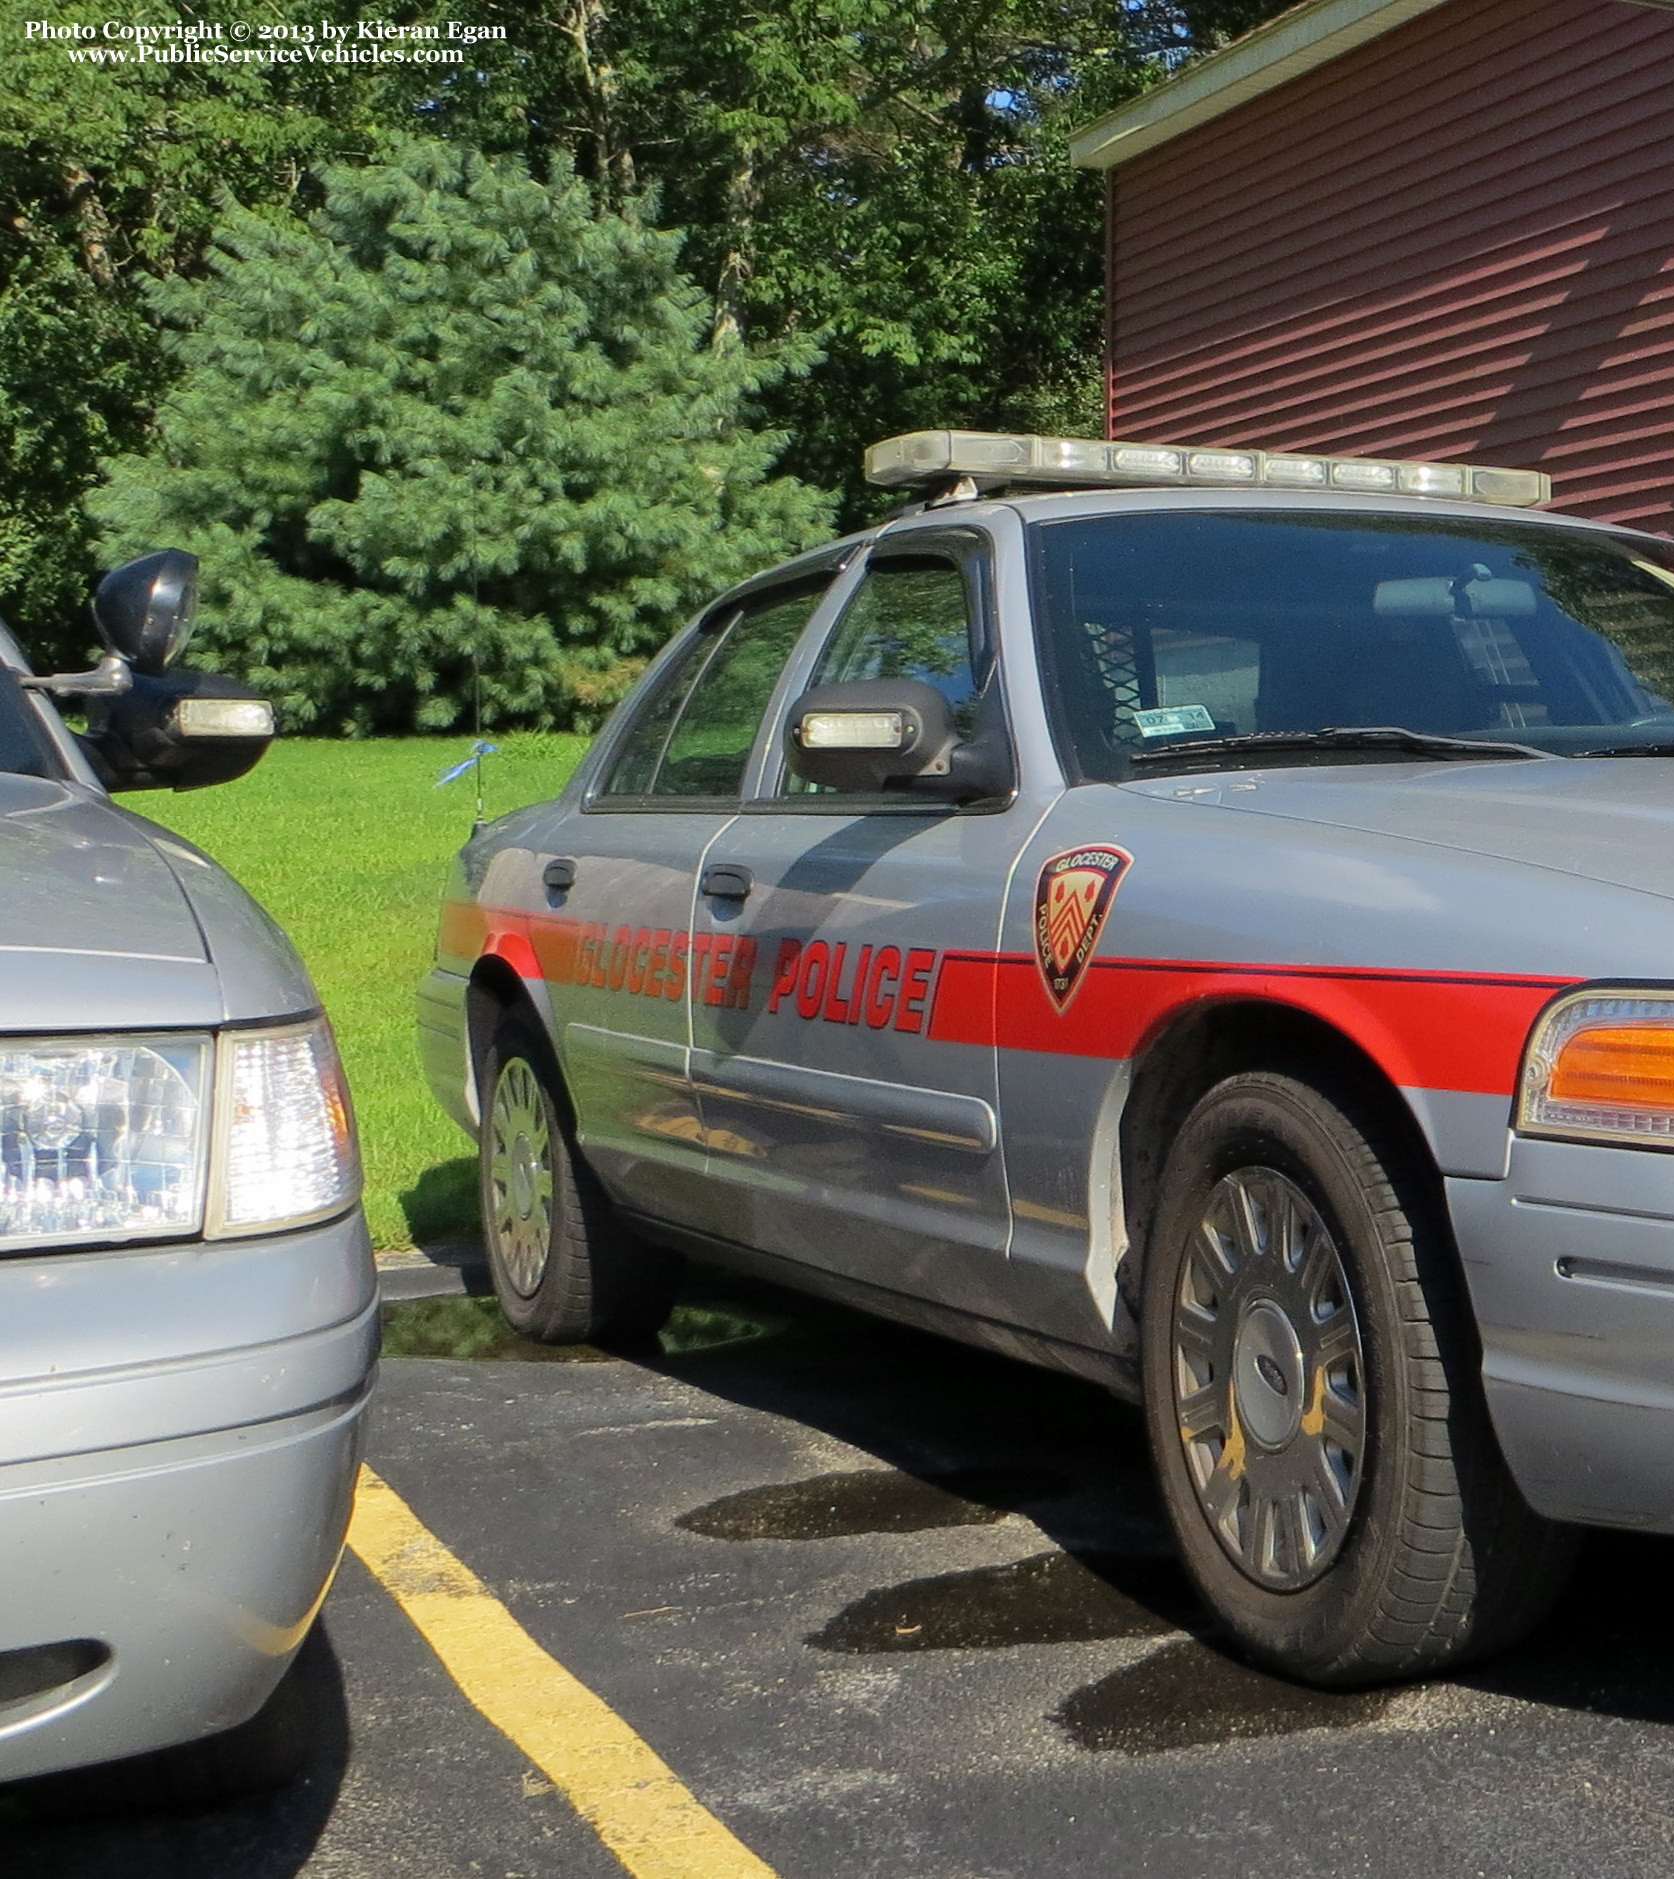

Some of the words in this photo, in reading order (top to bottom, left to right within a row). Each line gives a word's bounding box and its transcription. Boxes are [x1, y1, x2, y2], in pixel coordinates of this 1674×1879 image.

[1055, 852, 1119, 872] GLOCESTER
[1038, 903, 1054, 968] POLICE
[575, 921, 758, 1009] GLOCESTER
[768, 938, 936, 1034] POLICE
